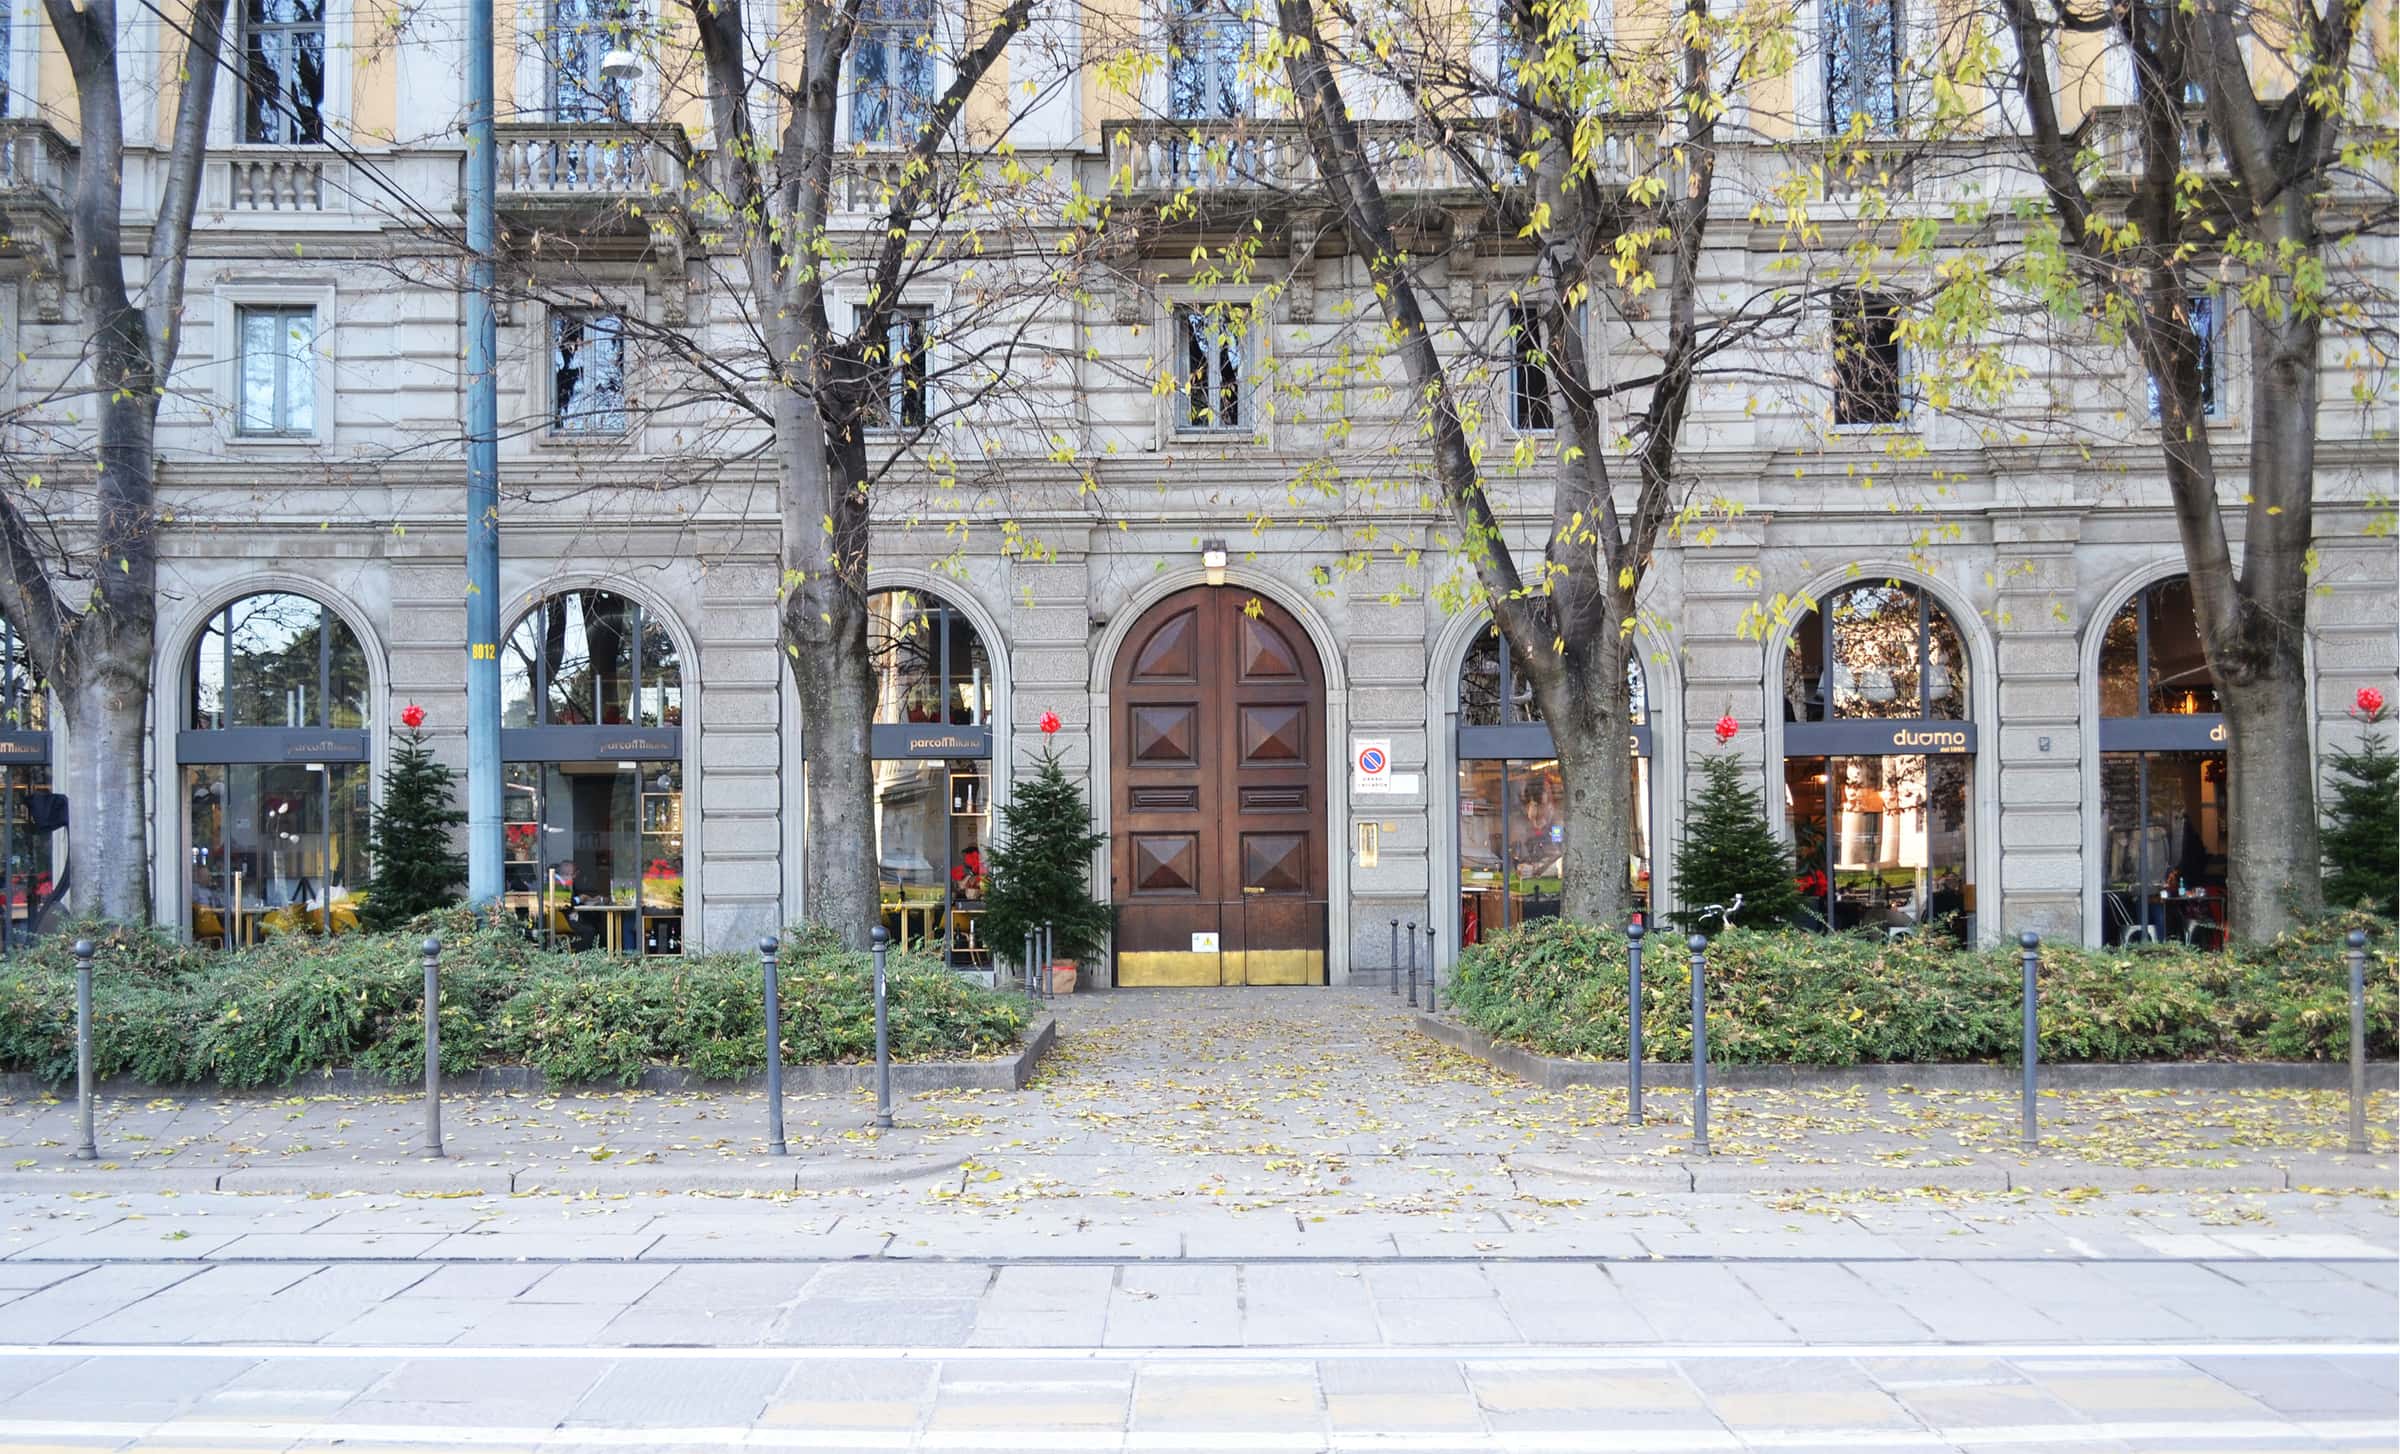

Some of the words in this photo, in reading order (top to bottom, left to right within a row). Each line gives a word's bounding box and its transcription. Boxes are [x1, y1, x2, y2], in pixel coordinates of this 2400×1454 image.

[472, 643, 496, 660] 8012
[1893, 728, 1966, 746] duomo
[287, 740, 358, 755] parcoM
